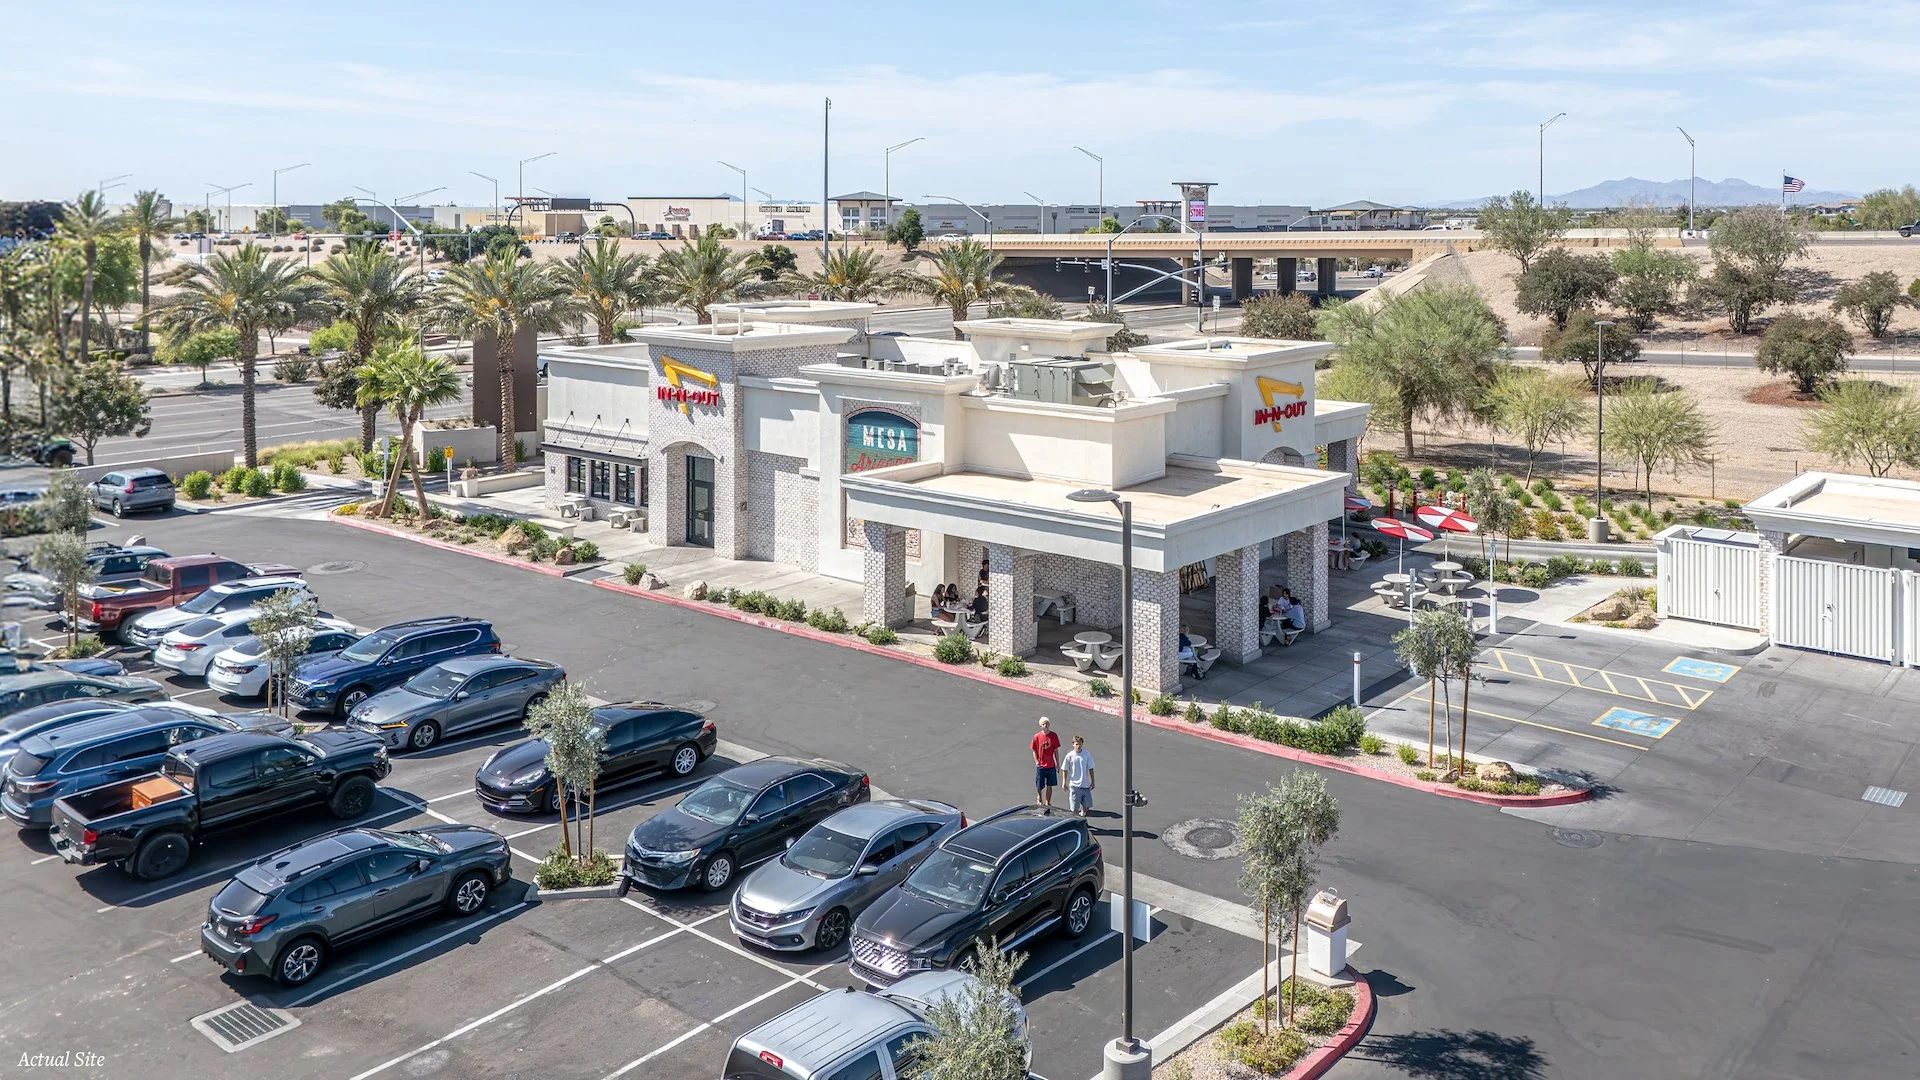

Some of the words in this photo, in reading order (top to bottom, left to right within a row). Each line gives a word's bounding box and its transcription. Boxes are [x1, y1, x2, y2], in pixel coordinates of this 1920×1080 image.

[1190, 208, 1204, 218] STORE
[657, 386, 720, 407] IN-N-OUT
[1254, 401, 1308, 426] IN-N-OUT
[863, 425, 907, 452] MESA
